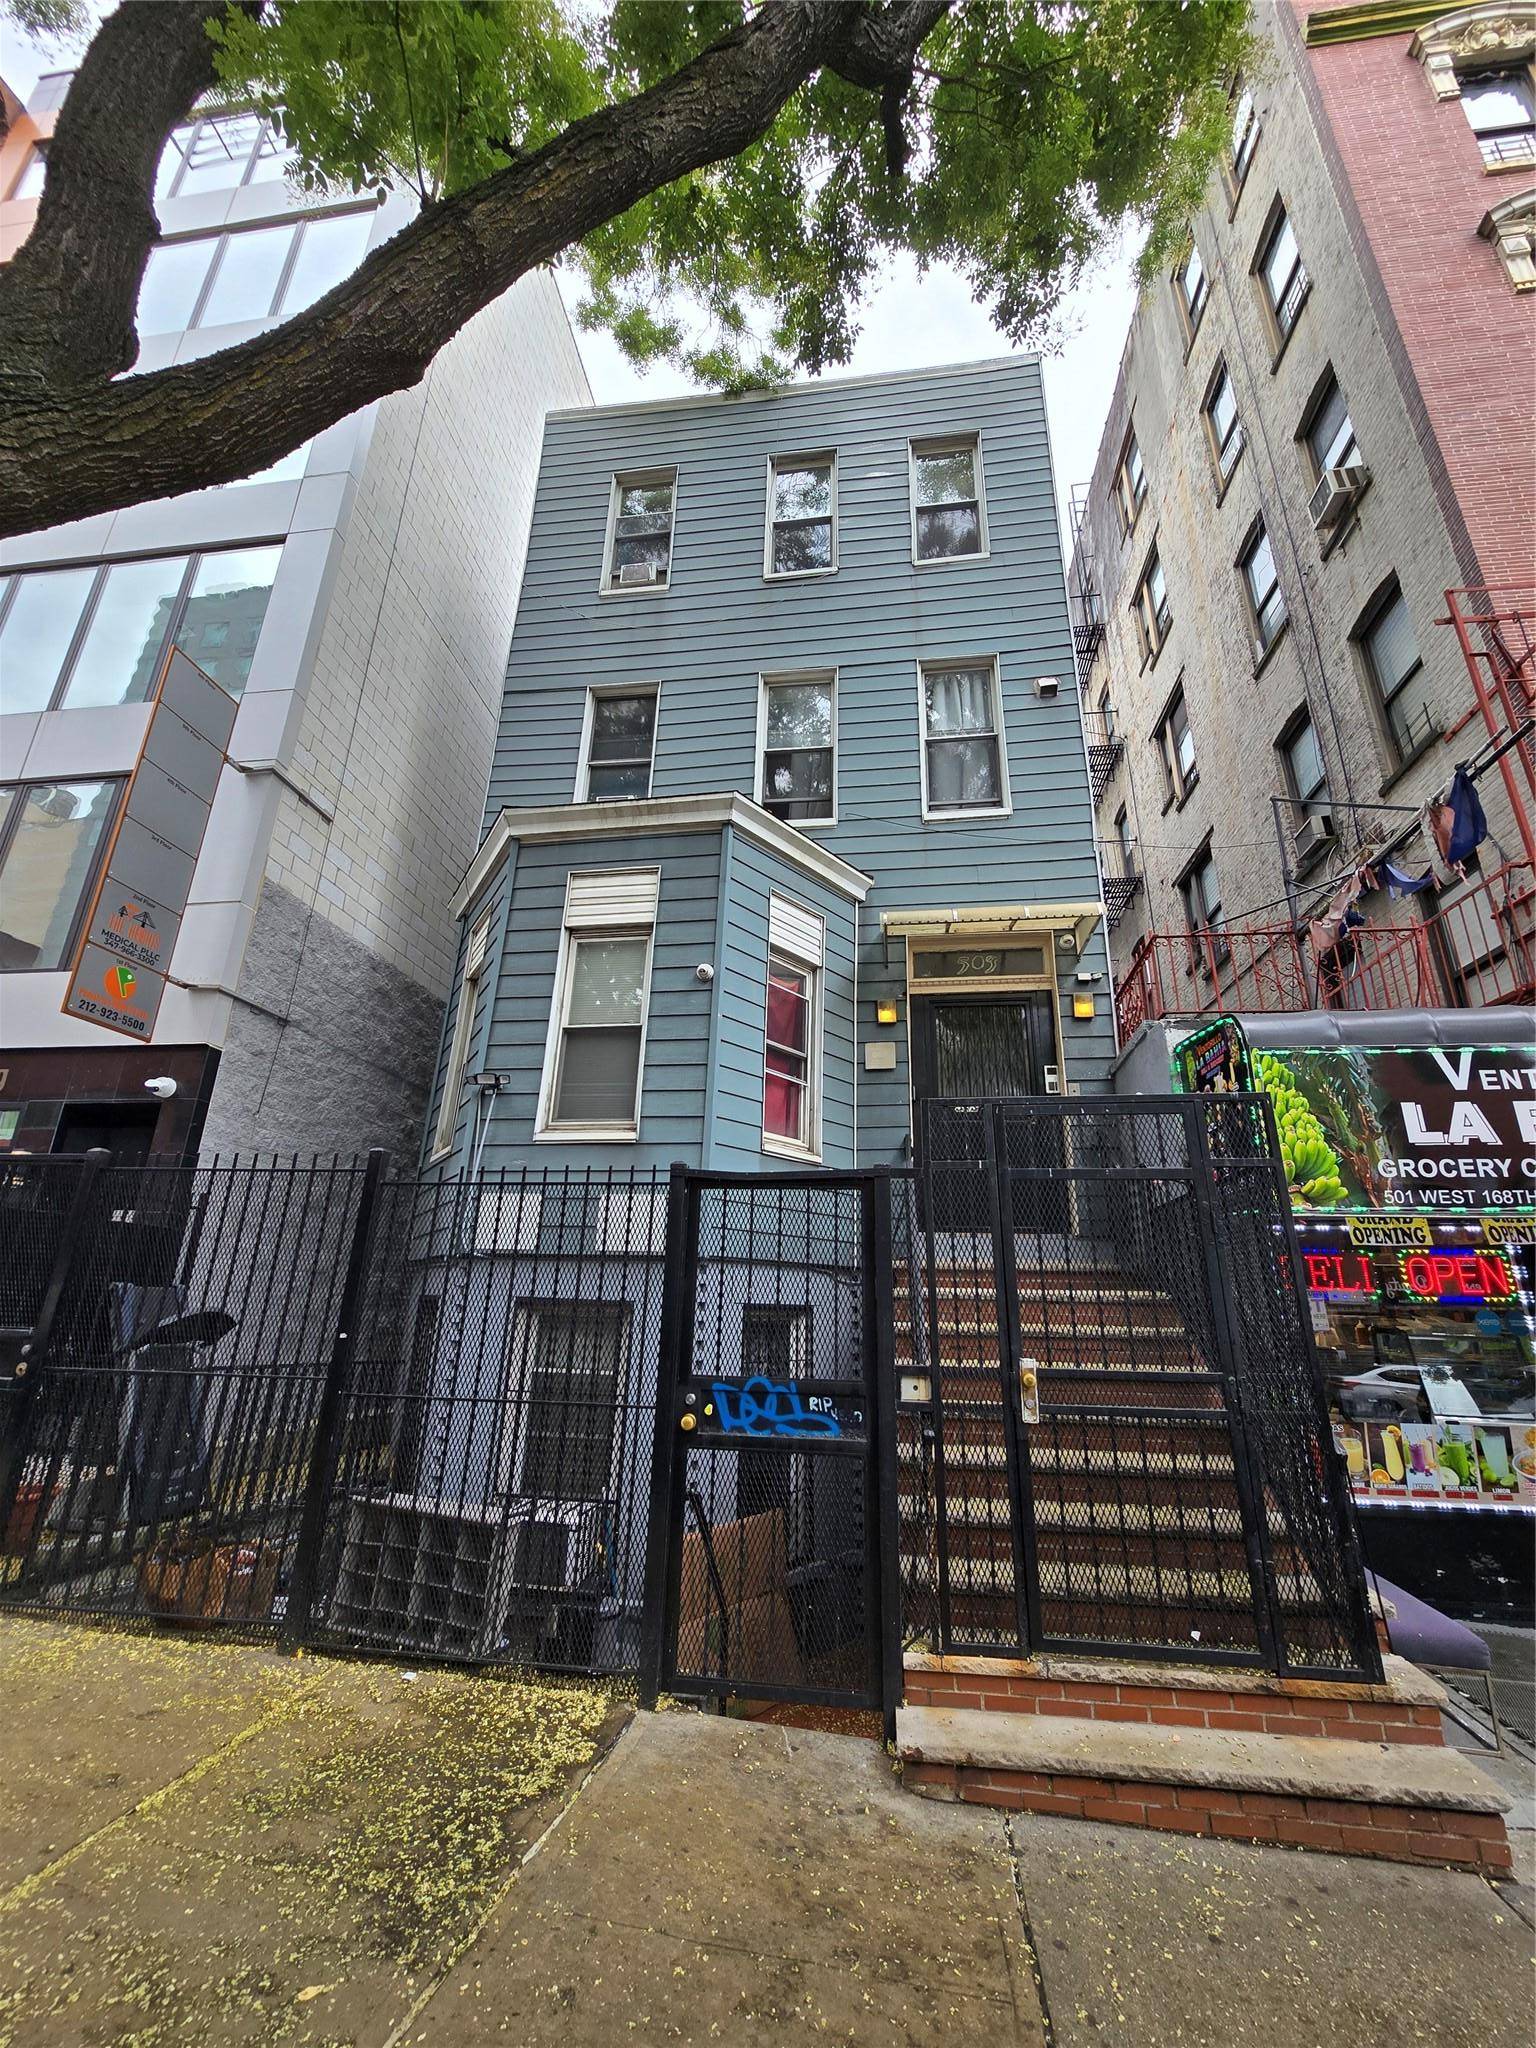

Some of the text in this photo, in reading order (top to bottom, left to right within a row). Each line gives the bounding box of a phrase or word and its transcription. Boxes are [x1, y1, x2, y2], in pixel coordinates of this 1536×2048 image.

[101, 928, 140, 953] MEDICAL
[140, 946, 160, 962] PLLC
[103, 938, 155, 967] 347-966-3300
[78, 999, 145, 1031] 212-923-5500
[1400, 1102, 1503, 1145] LA
[1378, 1158, 1512, 1178] GROCERY
[1384, 1190, 1414, 1204] 501
[1418, 1190, 1475, 1204] WEST
[1353, 1227, 1427, 1244] OPENING
[1407, 1256, 1510, 1294] OPEN
[808, 1396, 833, 1412] RIP
